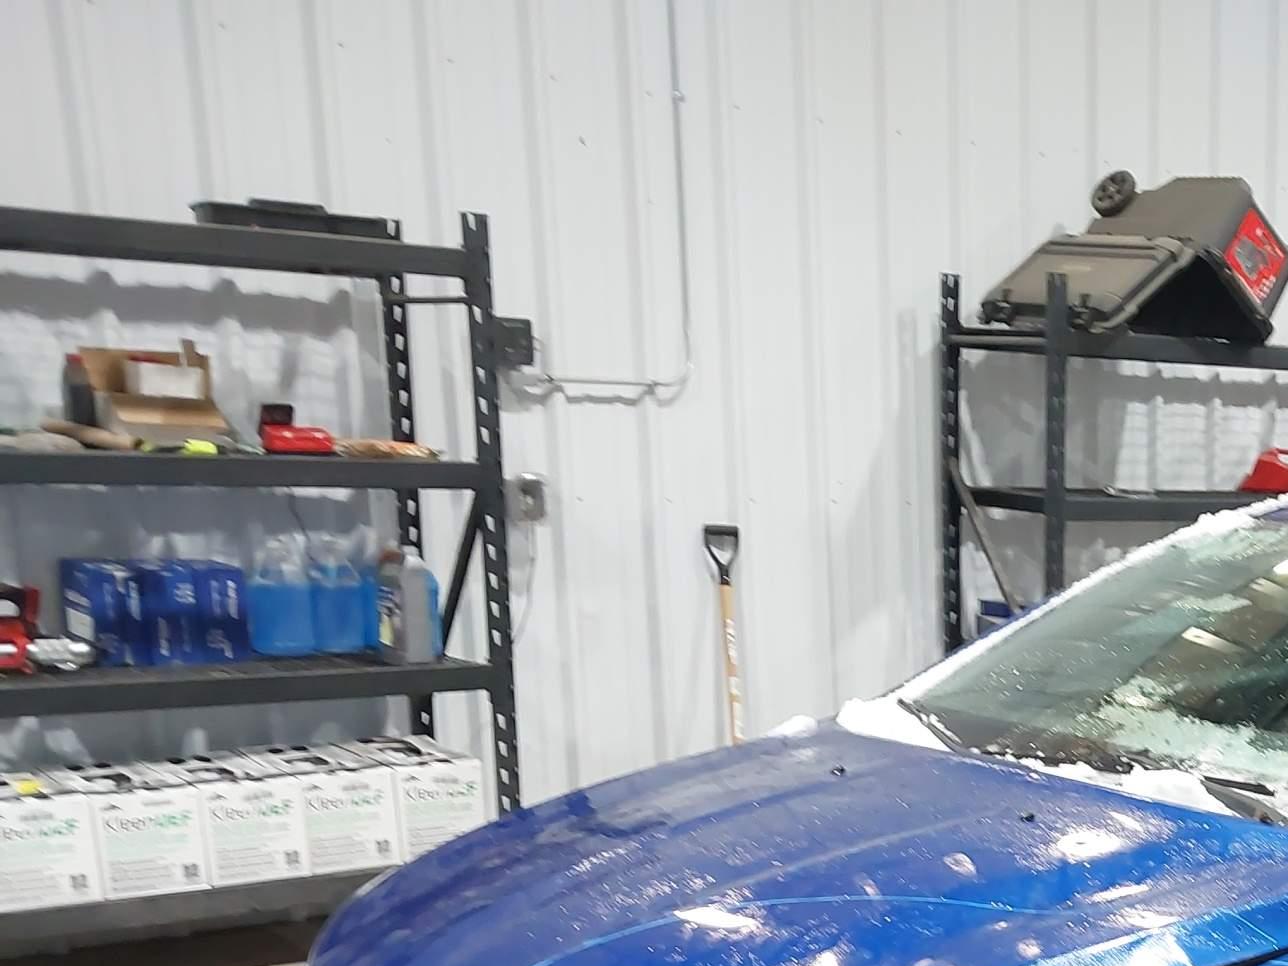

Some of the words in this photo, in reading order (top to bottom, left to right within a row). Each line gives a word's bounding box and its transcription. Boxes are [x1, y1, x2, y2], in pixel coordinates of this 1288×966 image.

[303, 790, 385, 812] Kleen
[402, 781, 480, 802] Kleen
[209, 799, 295, 822] Kleen
